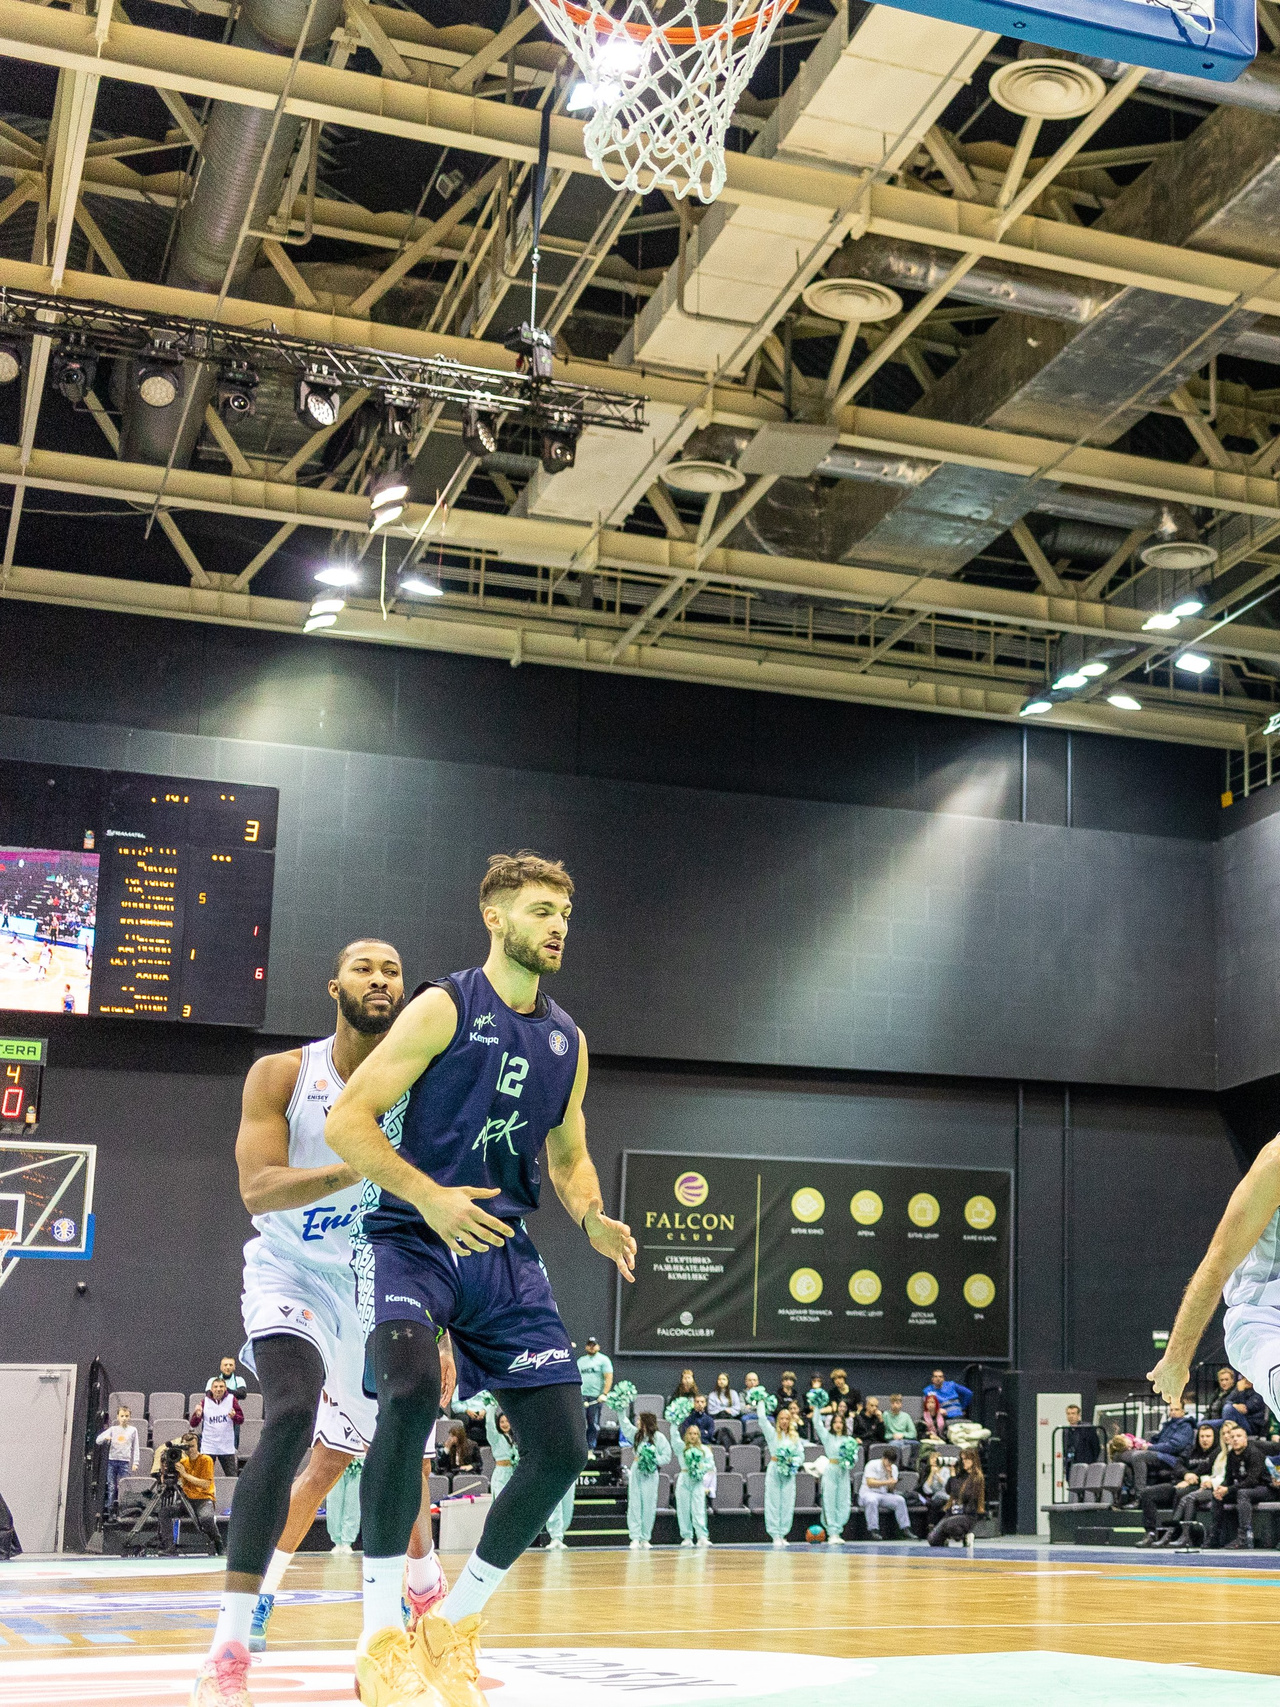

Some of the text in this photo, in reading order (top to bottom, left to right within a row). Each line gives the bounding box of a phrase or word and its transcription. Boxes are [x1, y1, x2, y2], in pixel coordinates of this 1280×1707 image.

[245, 820, 260, 842] 3
[198, 892, 207, 904] 5
[254, 967, 264, 980] 6
[181, 1004, 192, 1018] 3
[469, 1031, 499, 1046] Kempa
[0, 1044, 37, 1056] ERA
[6, 1064, 21, 1085] 4
[495, 1051, 530, 1098] 12
[1, 1087, 24, 1118] 0
[302, 1203, 359, 1242] Eni
[645, 1211, 736, 1231] FALCON
[666, 1232, 713, 1242] CLUB
[385, 1294, 422, 1309] Kempa
[656, 1327, 716, 1338] FALCONCLUB.BY
